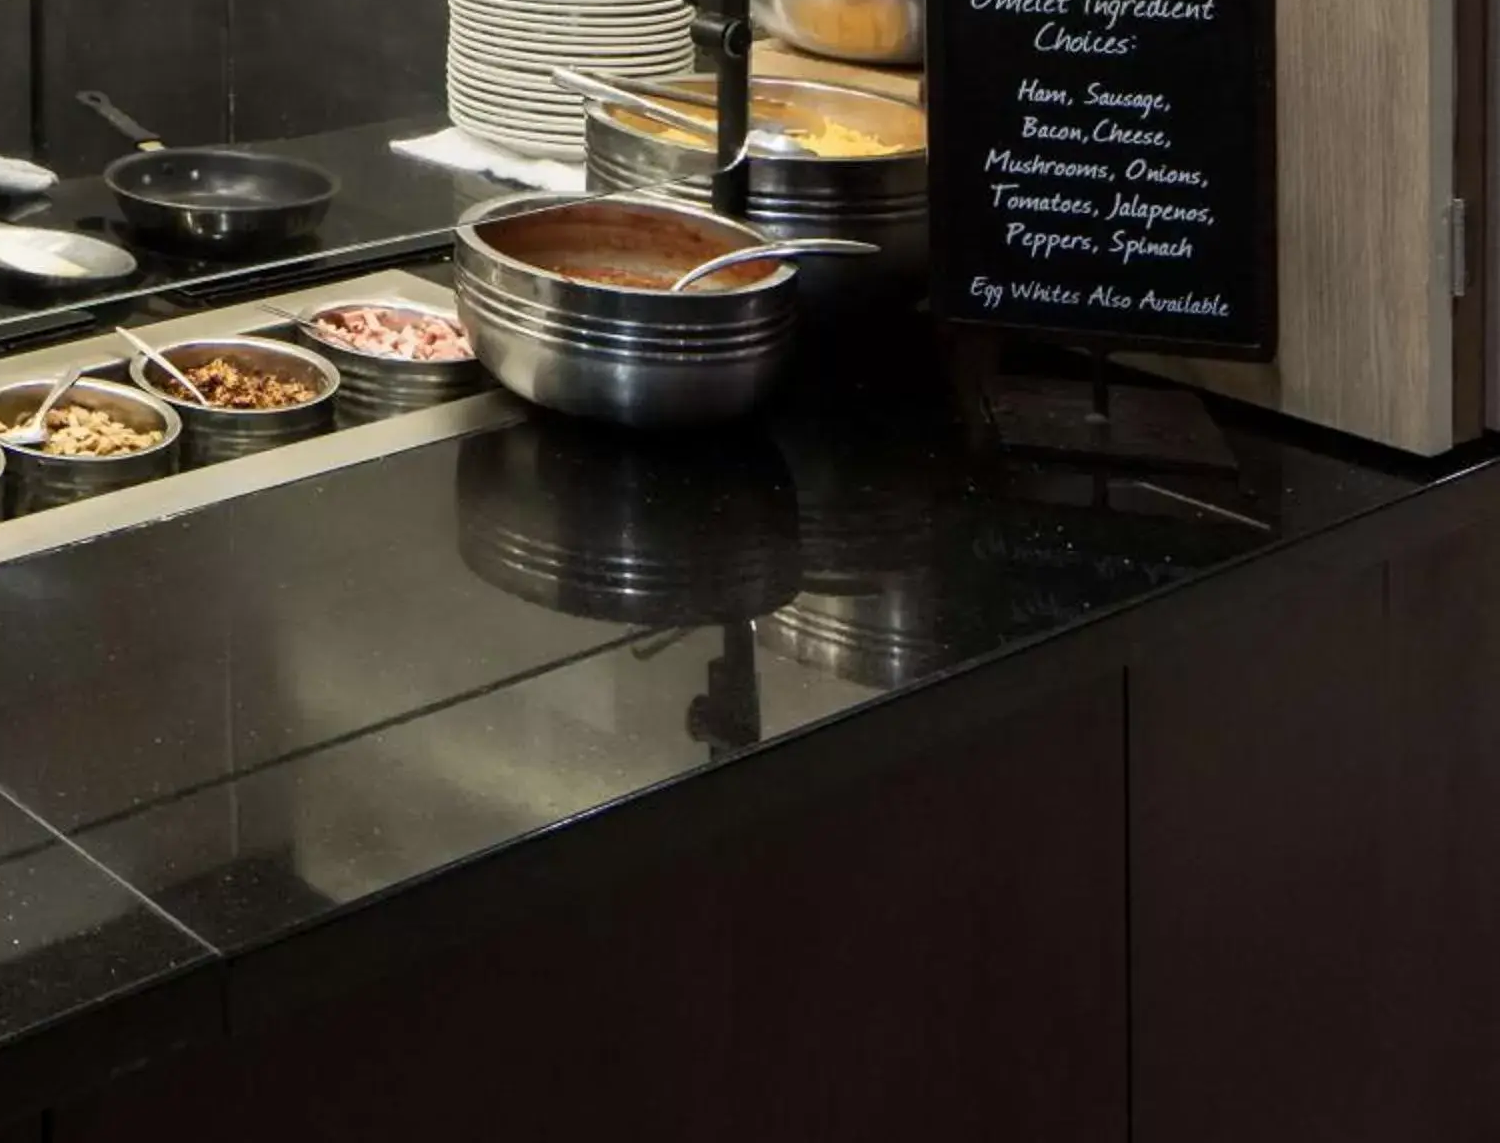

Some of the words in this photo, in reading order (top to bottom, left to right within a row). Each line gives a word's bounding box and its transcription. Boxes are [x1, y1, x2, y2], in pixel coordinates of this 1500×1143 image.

[1034, 22, 1138, 55] Choices:
[1017, 78, 1073, 106] Ham,
[1083, 82, 1172, 119] Sausage,
[1021, 116, 1089, 144] Bacon,
[1092, 119, 1172, 148] Cheese,
[984, 148, 1115, 182] Mushrooms,
[1125, 158, 1208, 188] Onions,
[990, 183, 1099, 218] Tomatoes,
[1105, 192, 1215, 228] Jalapenos,
[1006, 222, 1099, 258] Peppers,
[1109, 230, 1193, 264] Spinach
[970, 276, 1003, 307] Egg
[1011, 282, 1080, 304] Whites
[1088, 286, 1131, 308] Also
[1139, 290, 1230, 317] Available
